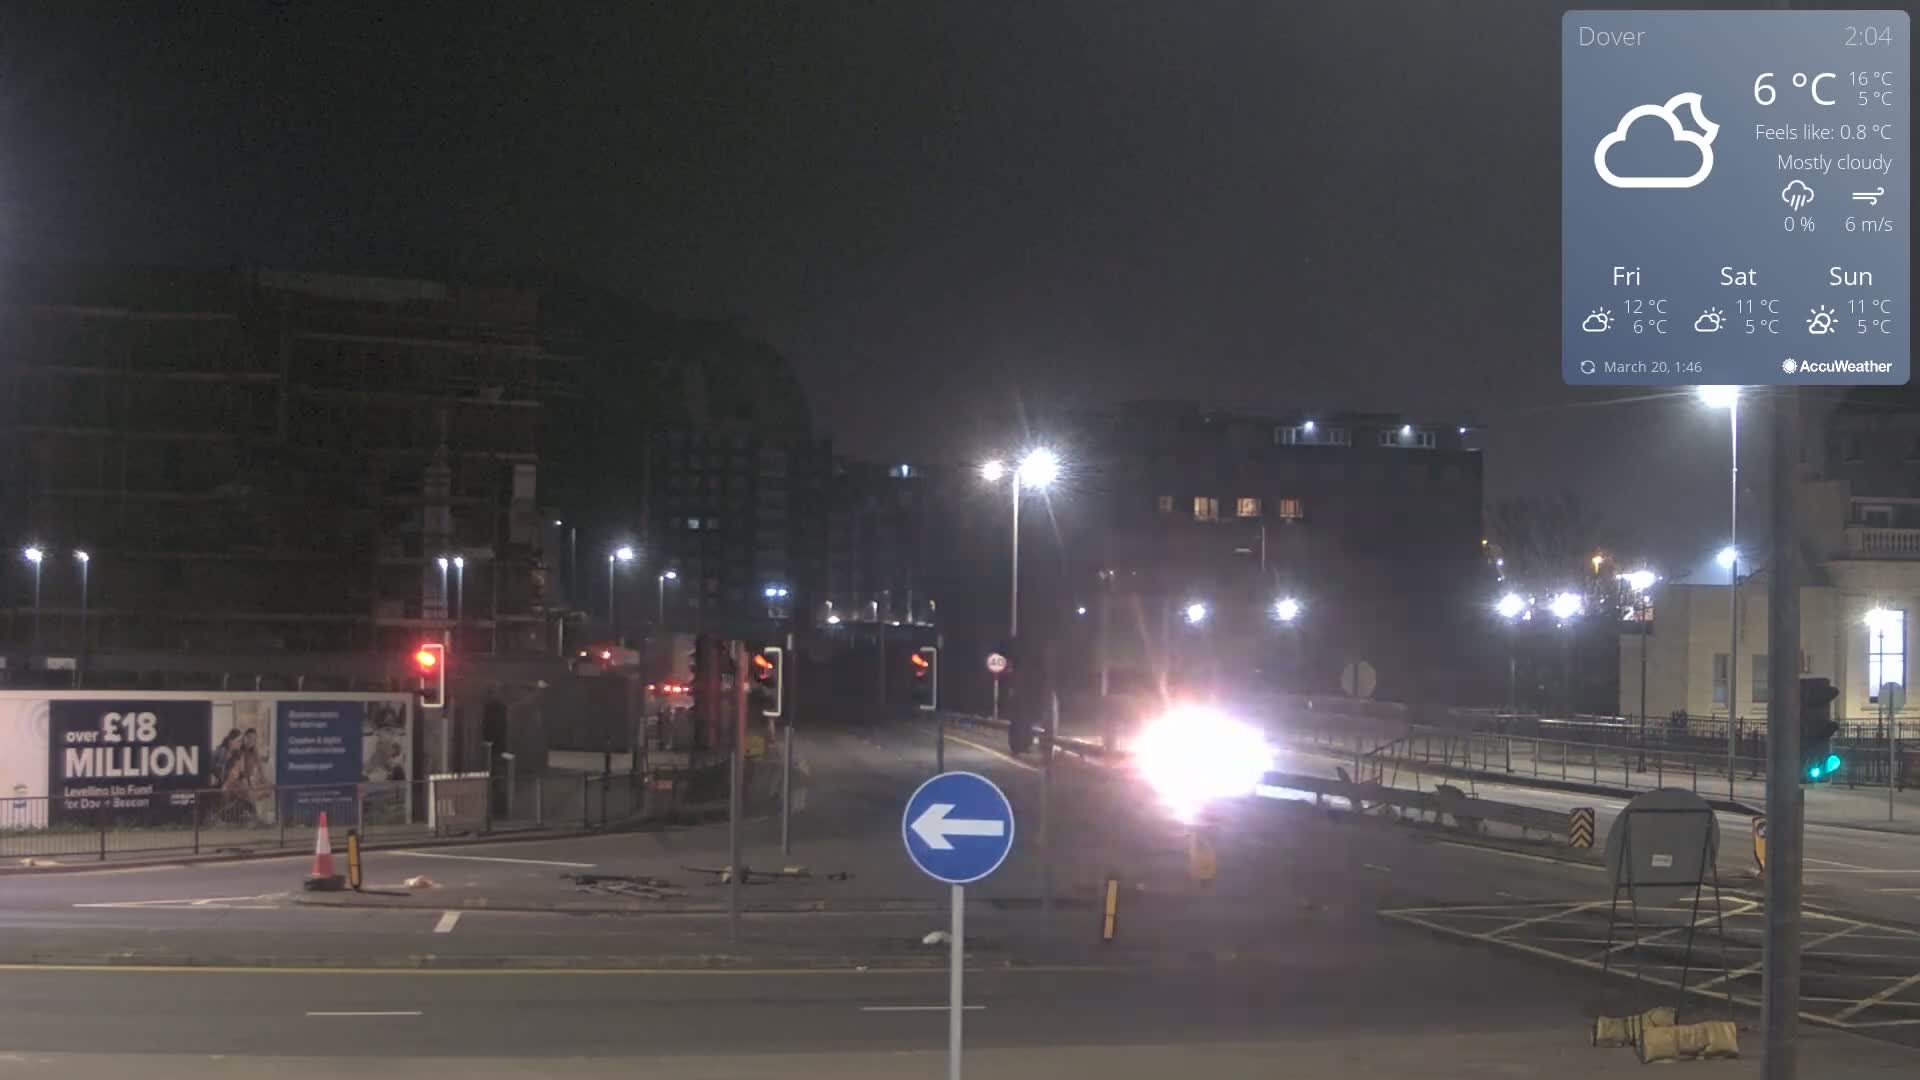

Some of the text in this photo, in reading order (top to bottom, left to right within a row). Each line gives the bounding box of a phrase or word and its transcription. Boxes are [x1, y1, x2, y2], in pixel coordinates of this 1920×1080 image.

[66, 711, 158, 742] over £18
[65, 745, 199, 777] MILLION
